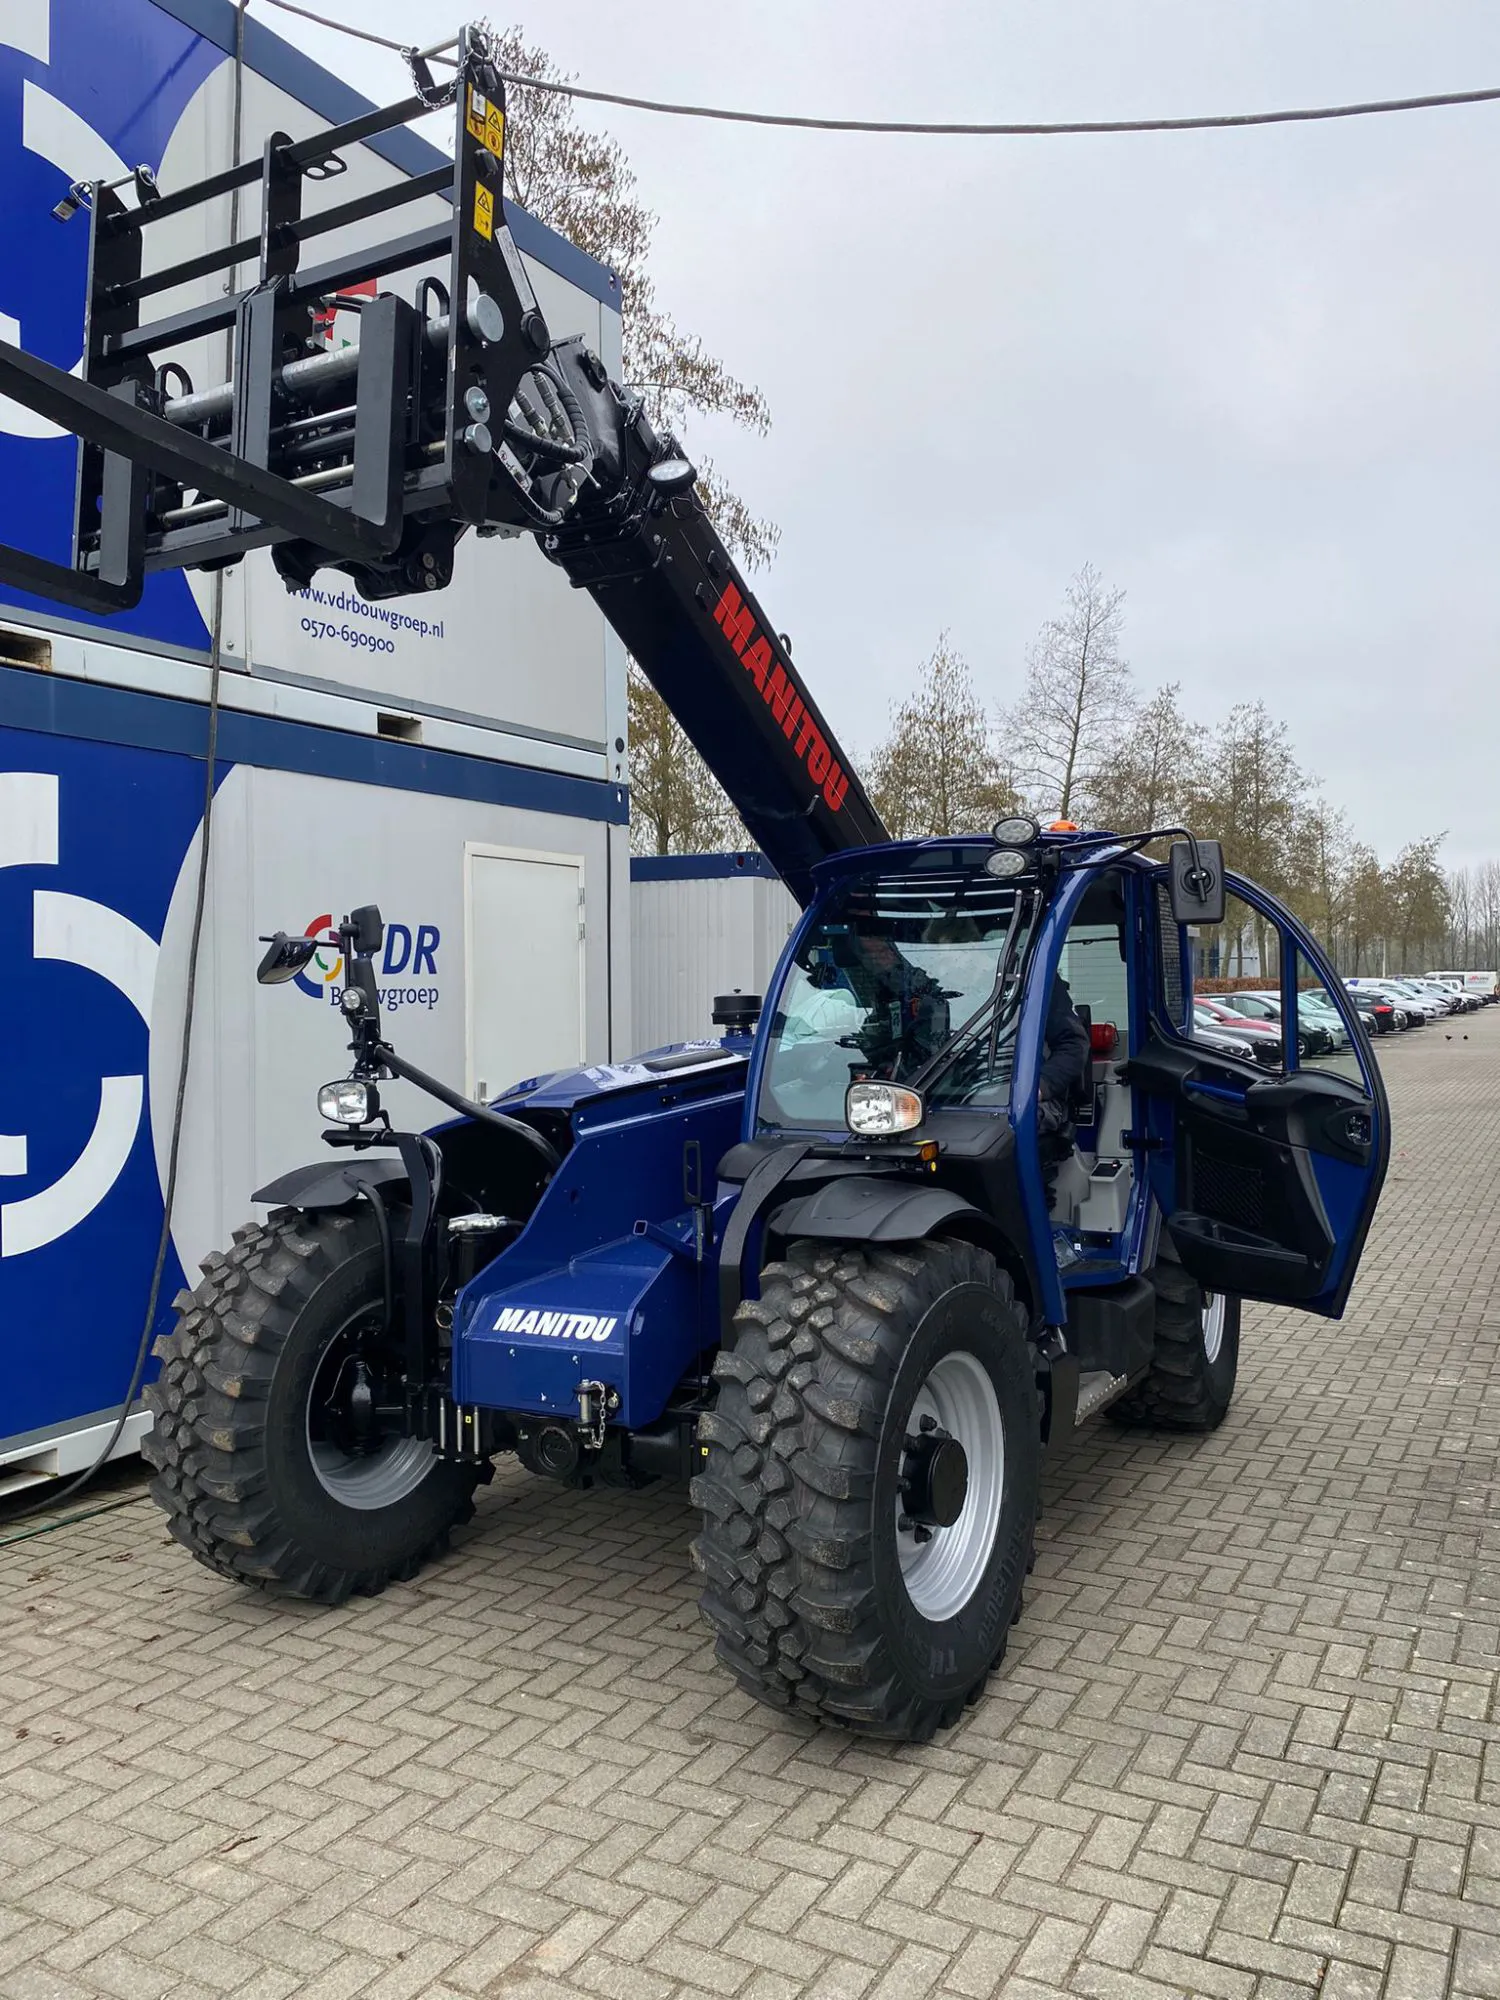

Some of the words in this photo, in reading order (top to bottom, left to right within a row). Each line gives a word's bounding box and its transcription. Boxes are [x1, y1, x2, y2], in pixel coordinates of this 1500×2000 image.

[286, 587, 444, 639] ww.vdrbouwgroep.nl
[301, 617, 395, 653] 0570-690900
[713, 581, 849, 812] MANITOU
[358, 924, 440, 975] DR
[330, 986, 439, 1012] Bwgroep
[492, 1307, 618, 1342] MANITOU
